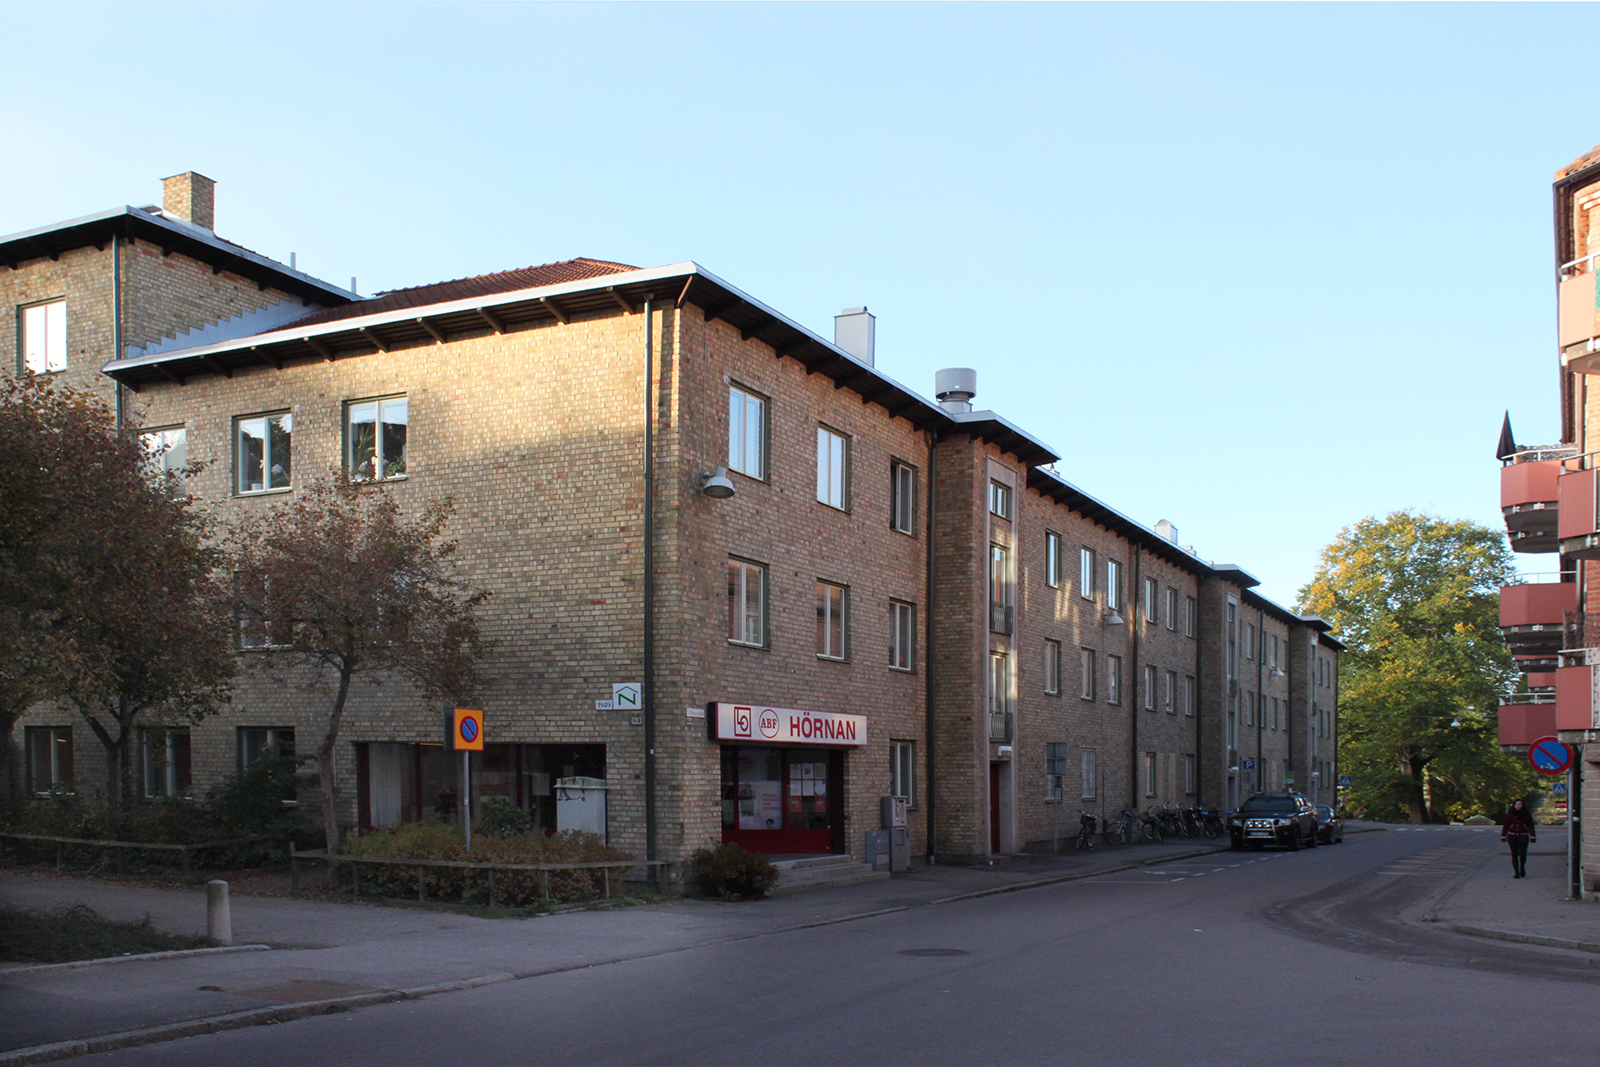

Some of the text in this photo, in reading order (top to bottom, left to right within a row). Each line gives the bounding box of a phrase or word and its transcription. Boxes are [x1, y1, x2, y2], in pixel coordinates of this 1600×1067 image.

[597, 701, 611, 709] 1949
[760, 717, 778, 729] ABF
[790, 712, 856, 740] HÖRNAN
[1247, 761, 1253, 769] P
